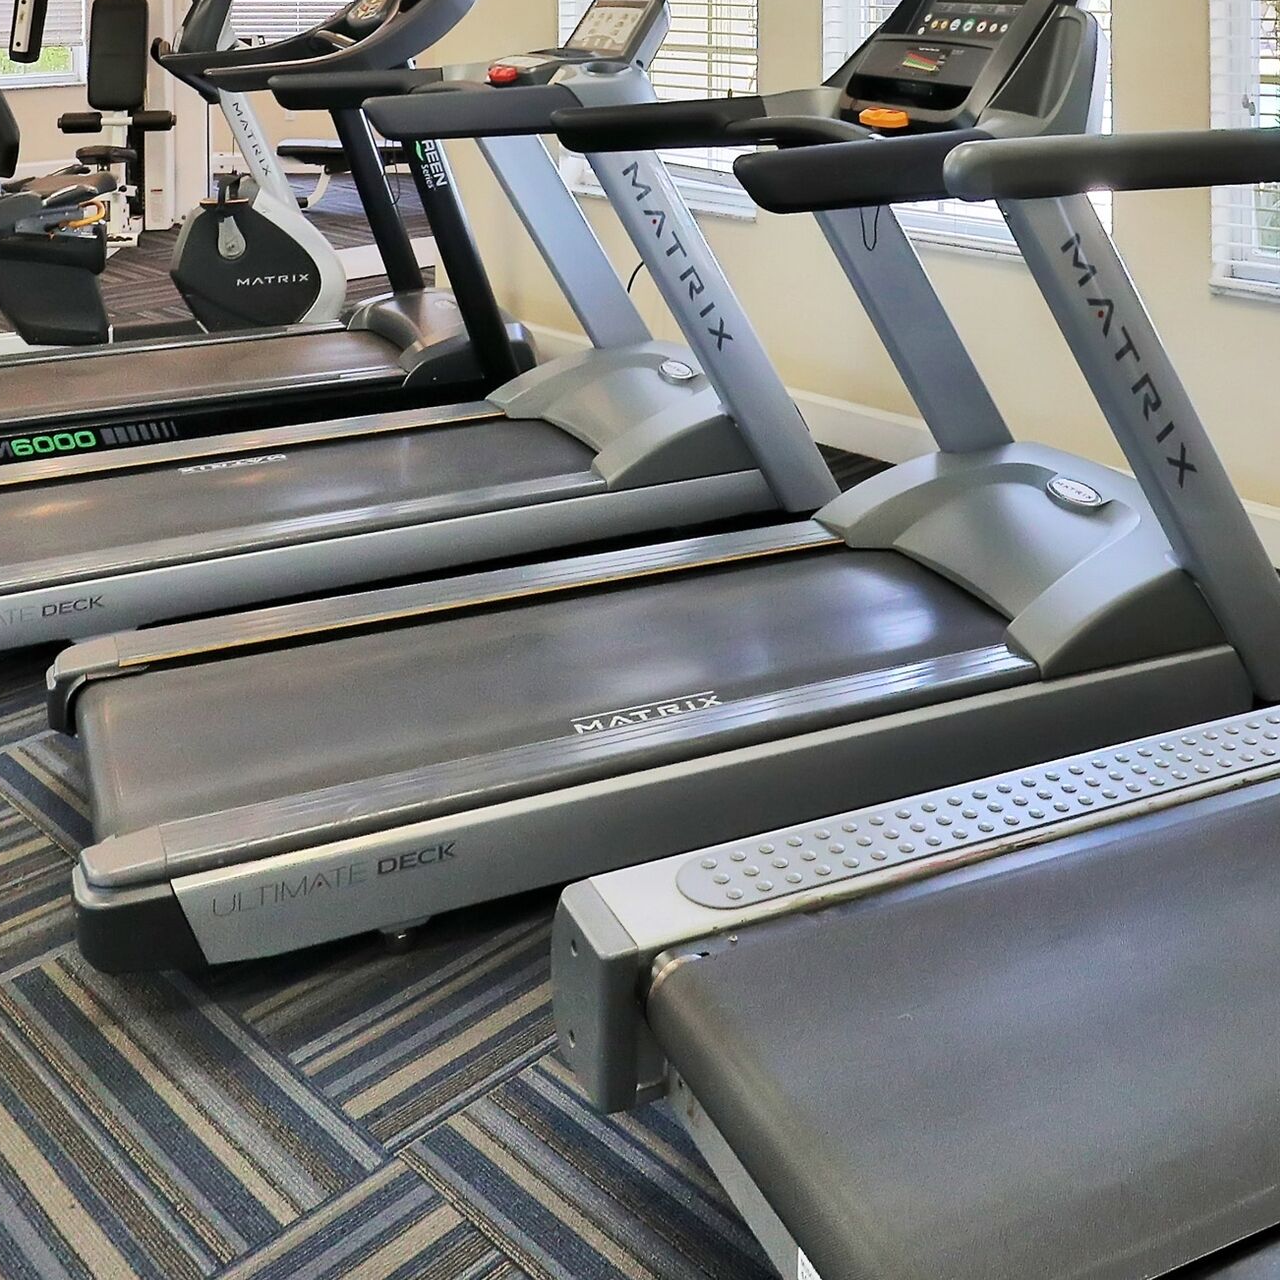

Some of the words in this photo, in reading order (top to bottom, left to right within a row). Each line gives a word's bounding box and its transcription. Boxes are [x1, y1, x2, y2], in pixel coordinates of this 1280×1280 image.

[232, 102, 271, 177] MATRIX
[421, 139, 448, 187] REEN
[236, 273, 309, 287] MATRIX
[622, 161, 733, 352] MATRIX
[1061, 233, 1197, 488] MATRIX
[42, 595, 104, 618] DECK
[573, 695, 722, 734] MATRIX
[212, 861, 368, 917] ULTIMATE
[377, 840, 456, 875] DECK
